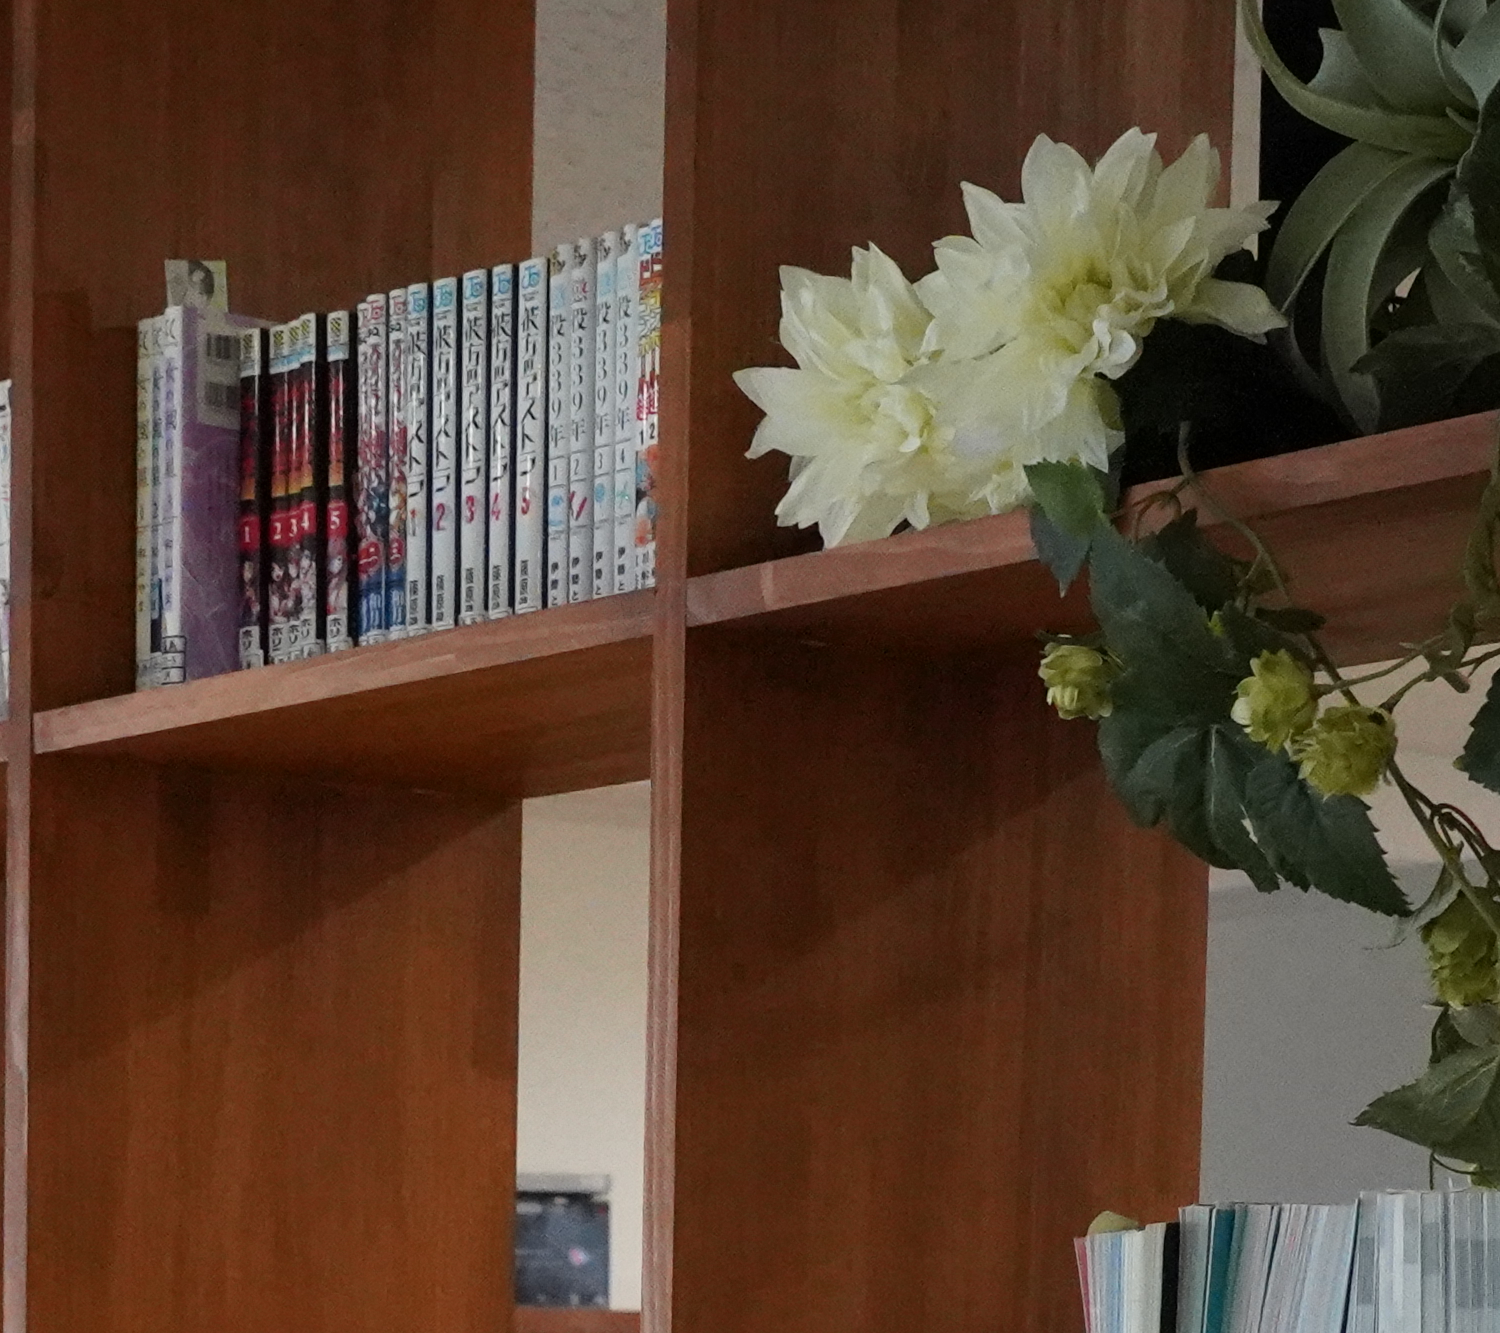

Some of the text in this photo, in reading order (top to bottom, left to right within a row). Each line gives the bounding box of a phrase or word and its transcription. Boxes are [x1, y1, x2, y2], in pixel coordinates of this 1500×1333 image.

[289, 518, 297, 537] 3
[301, 512, 310, 531] 4
[330, 511, 340, 530] 5
[244, 526, 250, 543] 1
[274, 522, 282, 541] 2
